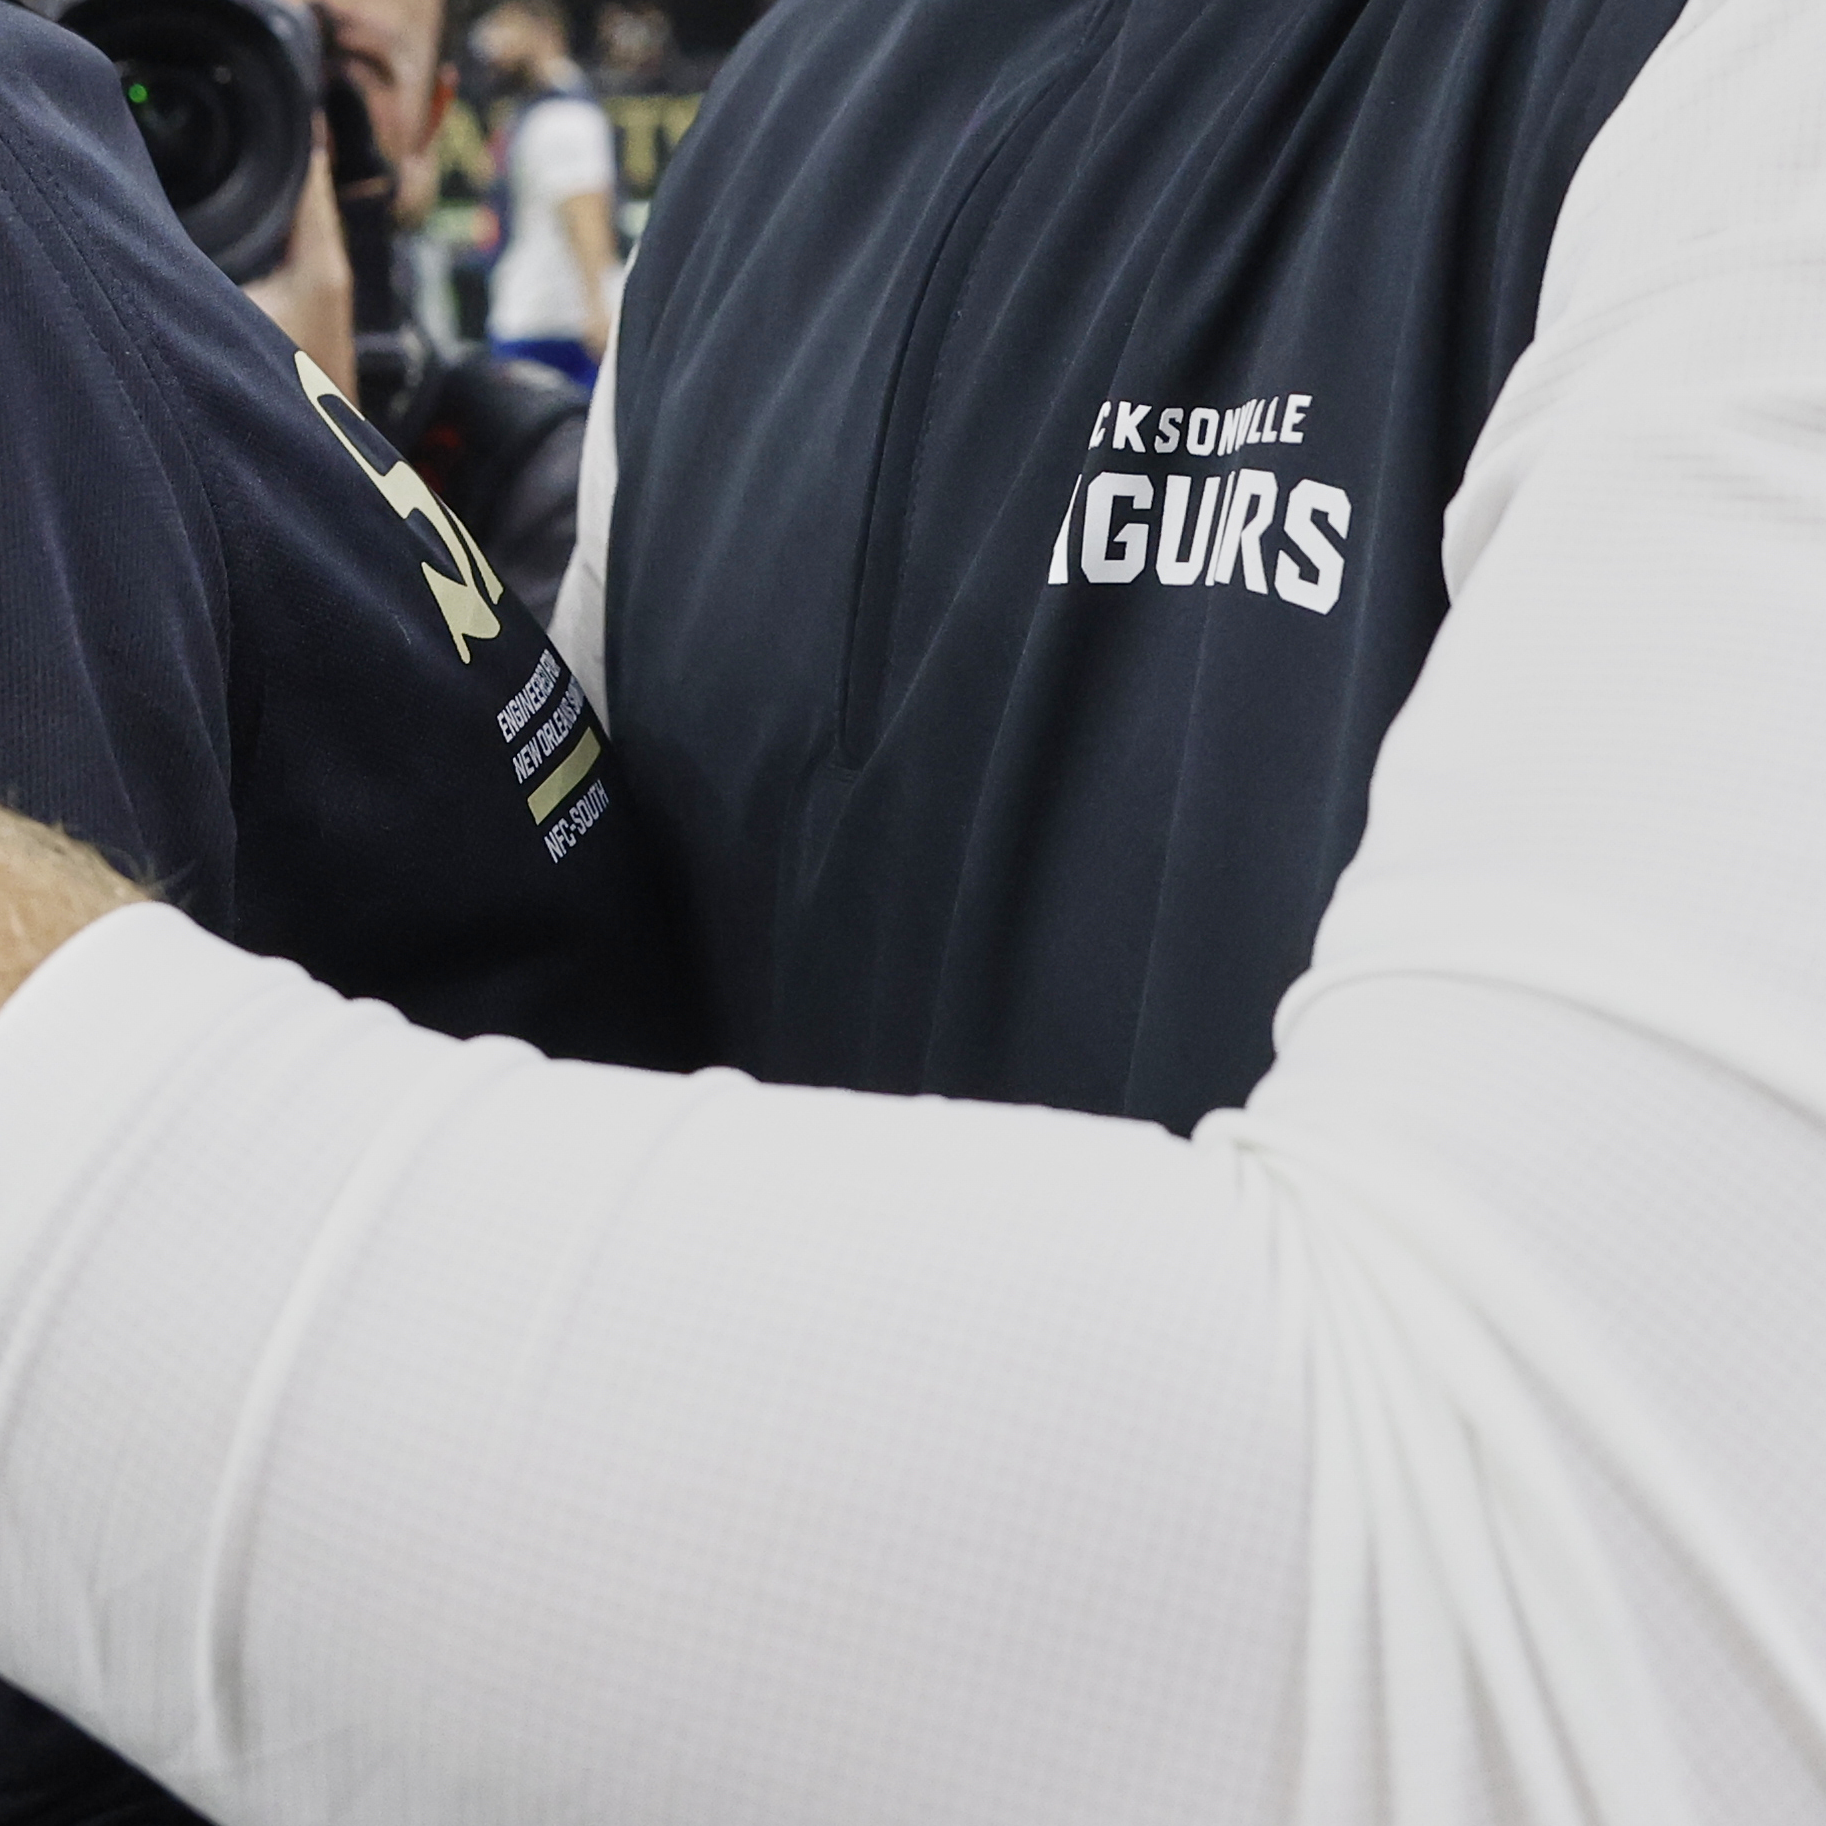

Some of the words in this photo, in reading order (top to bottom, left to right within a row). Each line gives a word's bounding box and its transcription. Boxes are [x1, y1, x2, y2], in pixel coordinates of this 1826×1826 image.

[1087, 393, 1313, 456] CKSONVILLE
[512, 737, 543, 784] NEW
[543, 778, 610, 864] NFC-SOUTH
